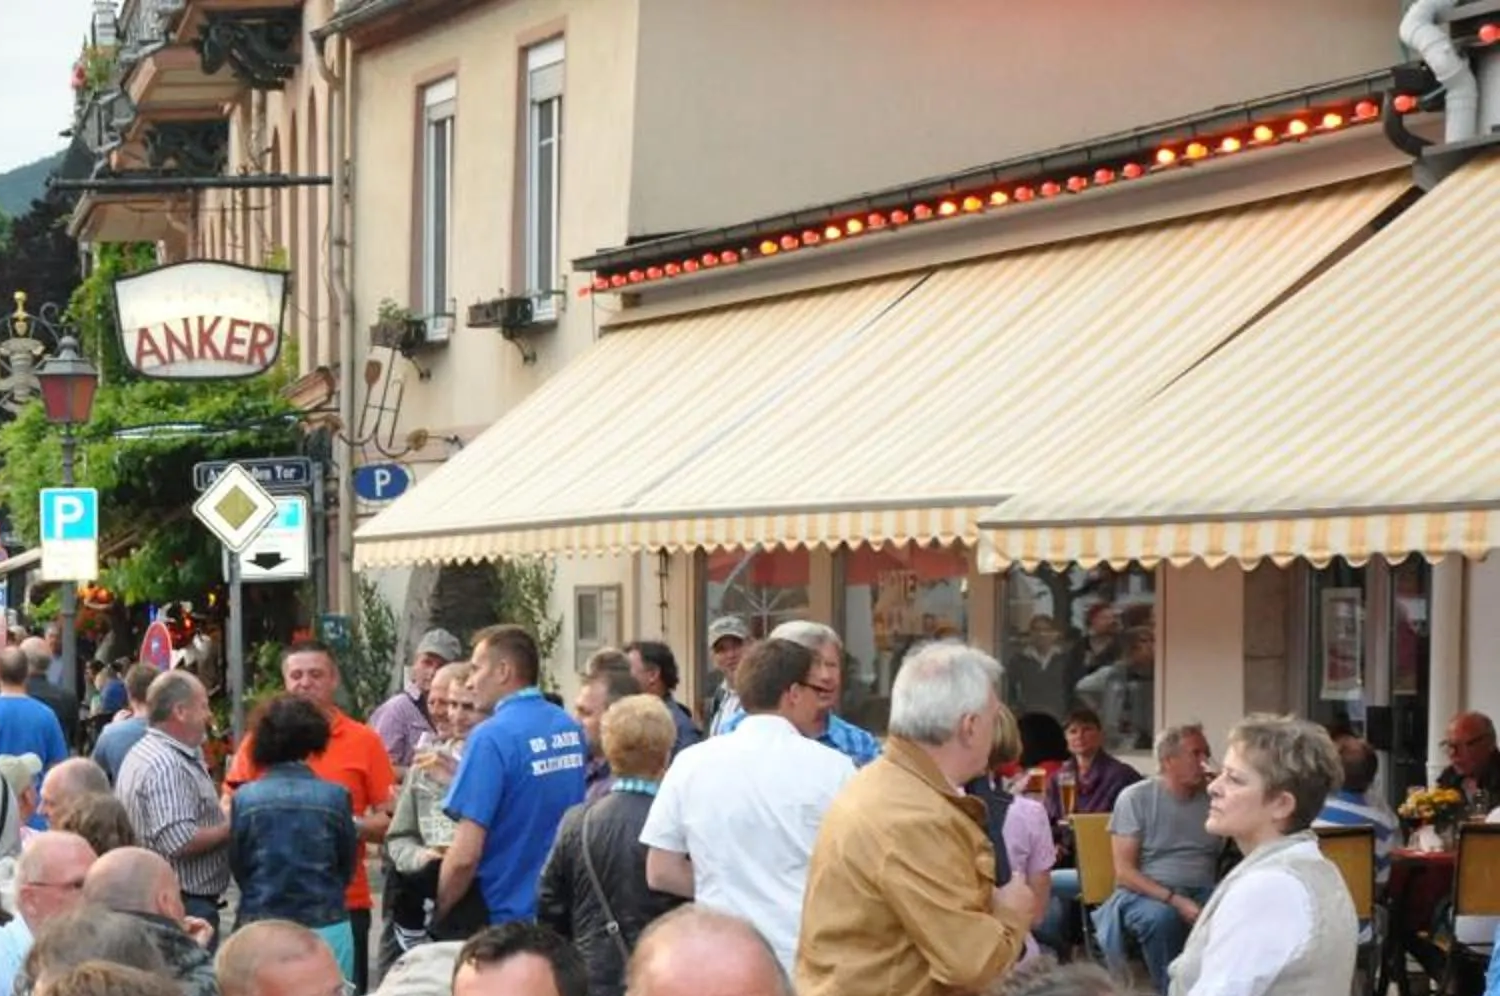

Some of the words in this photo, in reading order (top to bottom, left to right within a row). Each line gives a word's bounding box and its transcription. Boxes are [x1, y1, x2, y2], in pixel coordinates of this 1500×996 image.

[135, 315, 275, 371] ANKER
[374, 469, 391, 496] P
[53, 495, 85, 540] P
